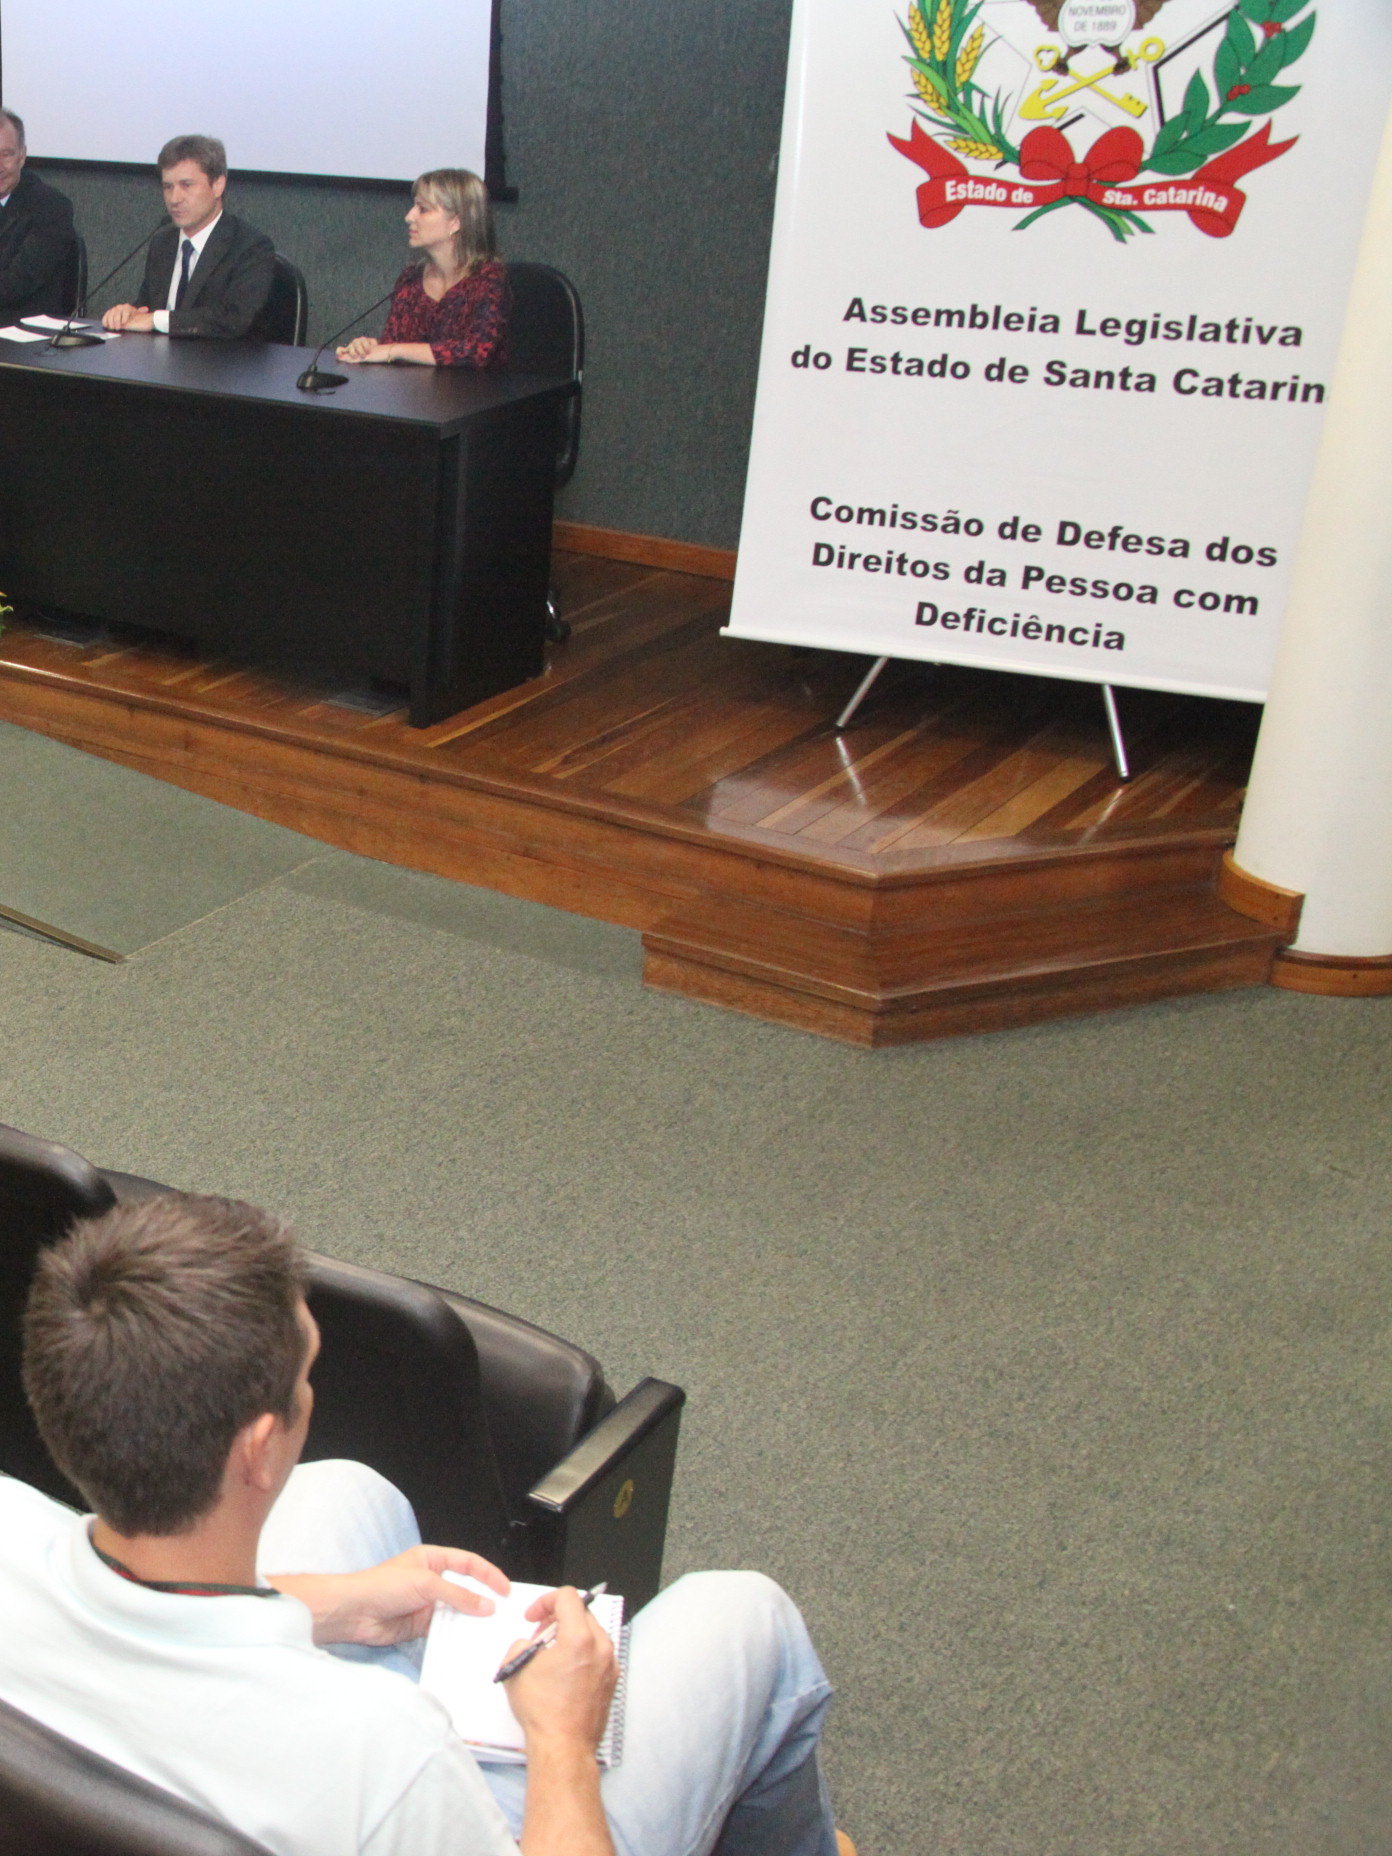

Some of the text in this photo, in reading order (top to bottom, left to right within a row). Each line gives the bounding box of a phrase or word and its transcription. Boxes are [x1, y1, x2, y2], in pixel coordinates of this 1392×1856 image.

[1068, 5, 1126, 17] NOVEMBRO
[1074, 20, 1117, 32] DE 1889
[945, 180, 1228, 213] Estado de Sta. Catarina
[842, 297, 1303, 347] Assembleia Legislativa
[791, 344, 1328, 404] do Estado de Santa Catarin
[810, 496, 1279, 568] Comissão de Defesa dos
[812, 542, 1259, 616] Direitos da Pessoa com
[915, 601, 1126, 651] Deficiência
